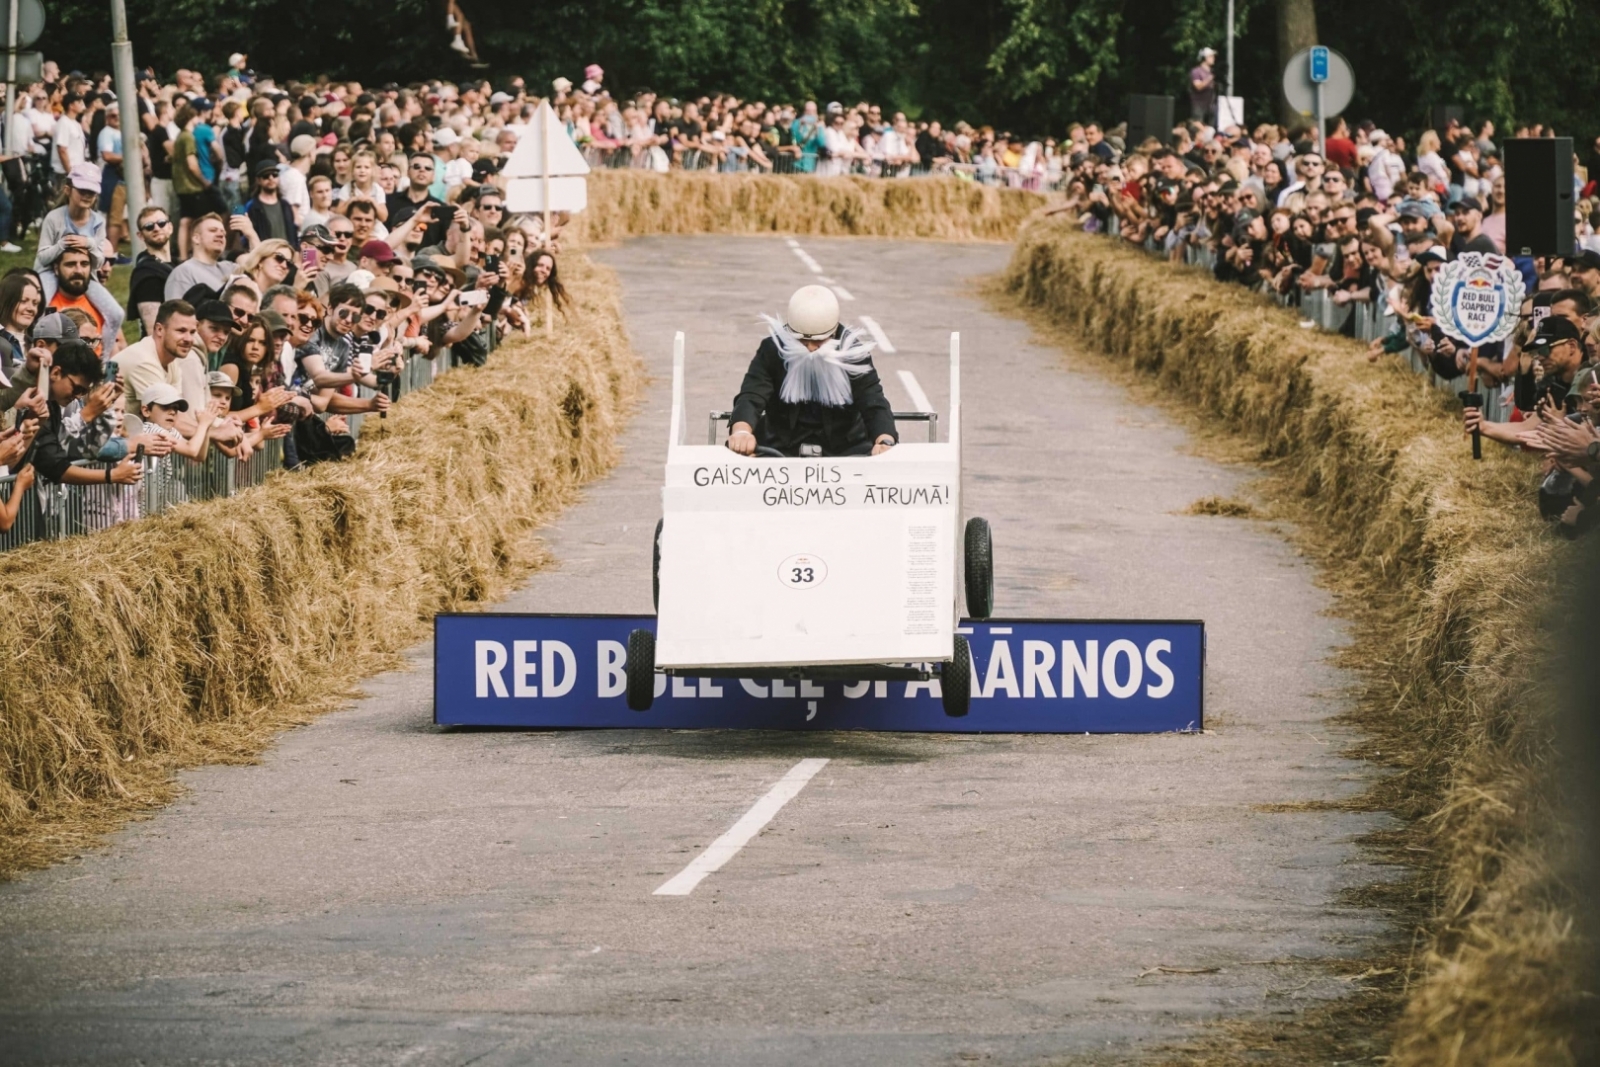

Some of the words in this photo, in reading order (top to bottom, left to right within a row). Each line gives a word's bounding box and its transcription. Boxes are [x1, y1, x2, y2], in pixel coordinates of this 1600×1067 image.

[1462, 291, 1477, 301] RED
[1478, 293, 1495, 302] BULL
[1460, 301, 1495, 313] SOAPBOX
[1467, 312, 1486, 321] RACE
[790, 567, 815, 583] 33
[474, 639, 578, 698] RED
